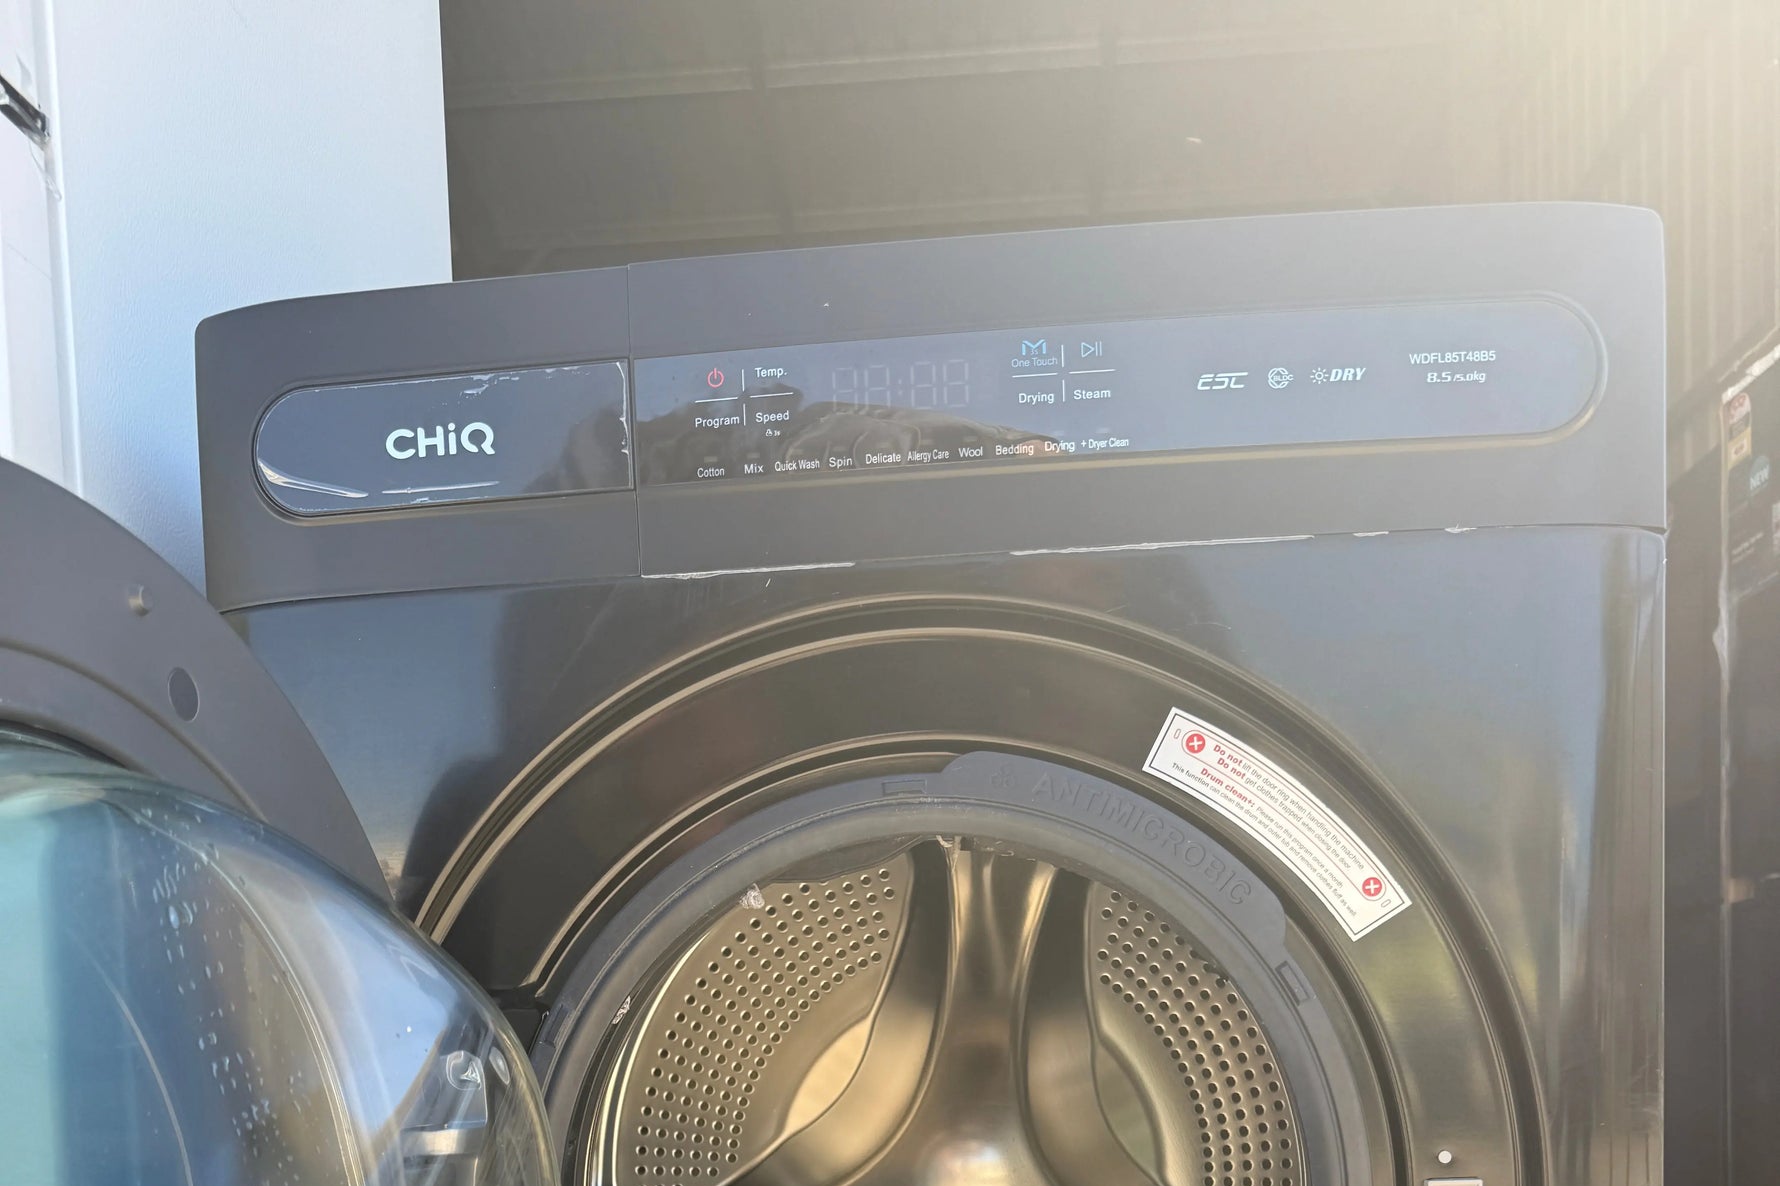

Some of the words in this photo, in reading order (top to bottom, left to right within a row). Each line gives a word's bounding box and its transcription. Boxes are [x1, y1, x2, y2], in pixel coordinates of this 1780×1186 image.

[1011, 358, 1031, 368] One
[1032, 356, 1058, 367] Touch
[1408, 350, 1496, 365] WDFL85T48B5
[755, 366, 788, 379] Temp.
[1329, 367, 1367, 382] DRY
[1197, 371, 1249, 391] ESC
[1018, 392, 1055, 405] Drying
[1073, 389, 1111, 400] Steam
[695, 415, 740, 429] Program
[755, 411, 790, 425] Speed
[385, 422, 495, 460] CHiQ
[1044, 440, 1076, 453] Drying
[1088, 439, 1108, 450] Dryer
[1108, 437, 1129, 448] Clean
[907, 451, 932, 463] Allergy
[932, 449, 950, 461] Care
[958, 446, 984, 458] Wool
[995, 444, 1034, 456] Bedding
[828, 456, 853, 469] Spin
[865, 453, 902, 465] Delicate
[697, 467, 725, 478] Cotton
[744, 464, 764, 475] Mix
[774, 460, 797, 473] Quick
[797, 459, 820, 471] Wash
[1200, 767, 1224, 787] Drum
[1256, 806, 1274, 823] Please
[1213, 744, 1226, 756] Do
[1227, 754, 1242, 766] not
[1251, 769, 1262, 780] the
[1262, 778, 1277, 790] door
[1277, 789, 1290, 801] ring
[1290, 799, 1307, 815] when
[1306, 811, 1331, 837] handling
[1331, 834, 1341, 845] the
[1217, 758, 1229, 769] Do
[1230, 767, 1246, 779] not
[1244, 777, 1257, 788] get
[1256, 785, 1279, 803] clothes
[1278, 800, 1303, 822] trapped
[1301, 821, 1315, 834] when
[1314, 833, 1332, 851] closing
[1331, 848, 1340, 858] the
[1031, 772, 1252, 906] ANTIMICROBIC
